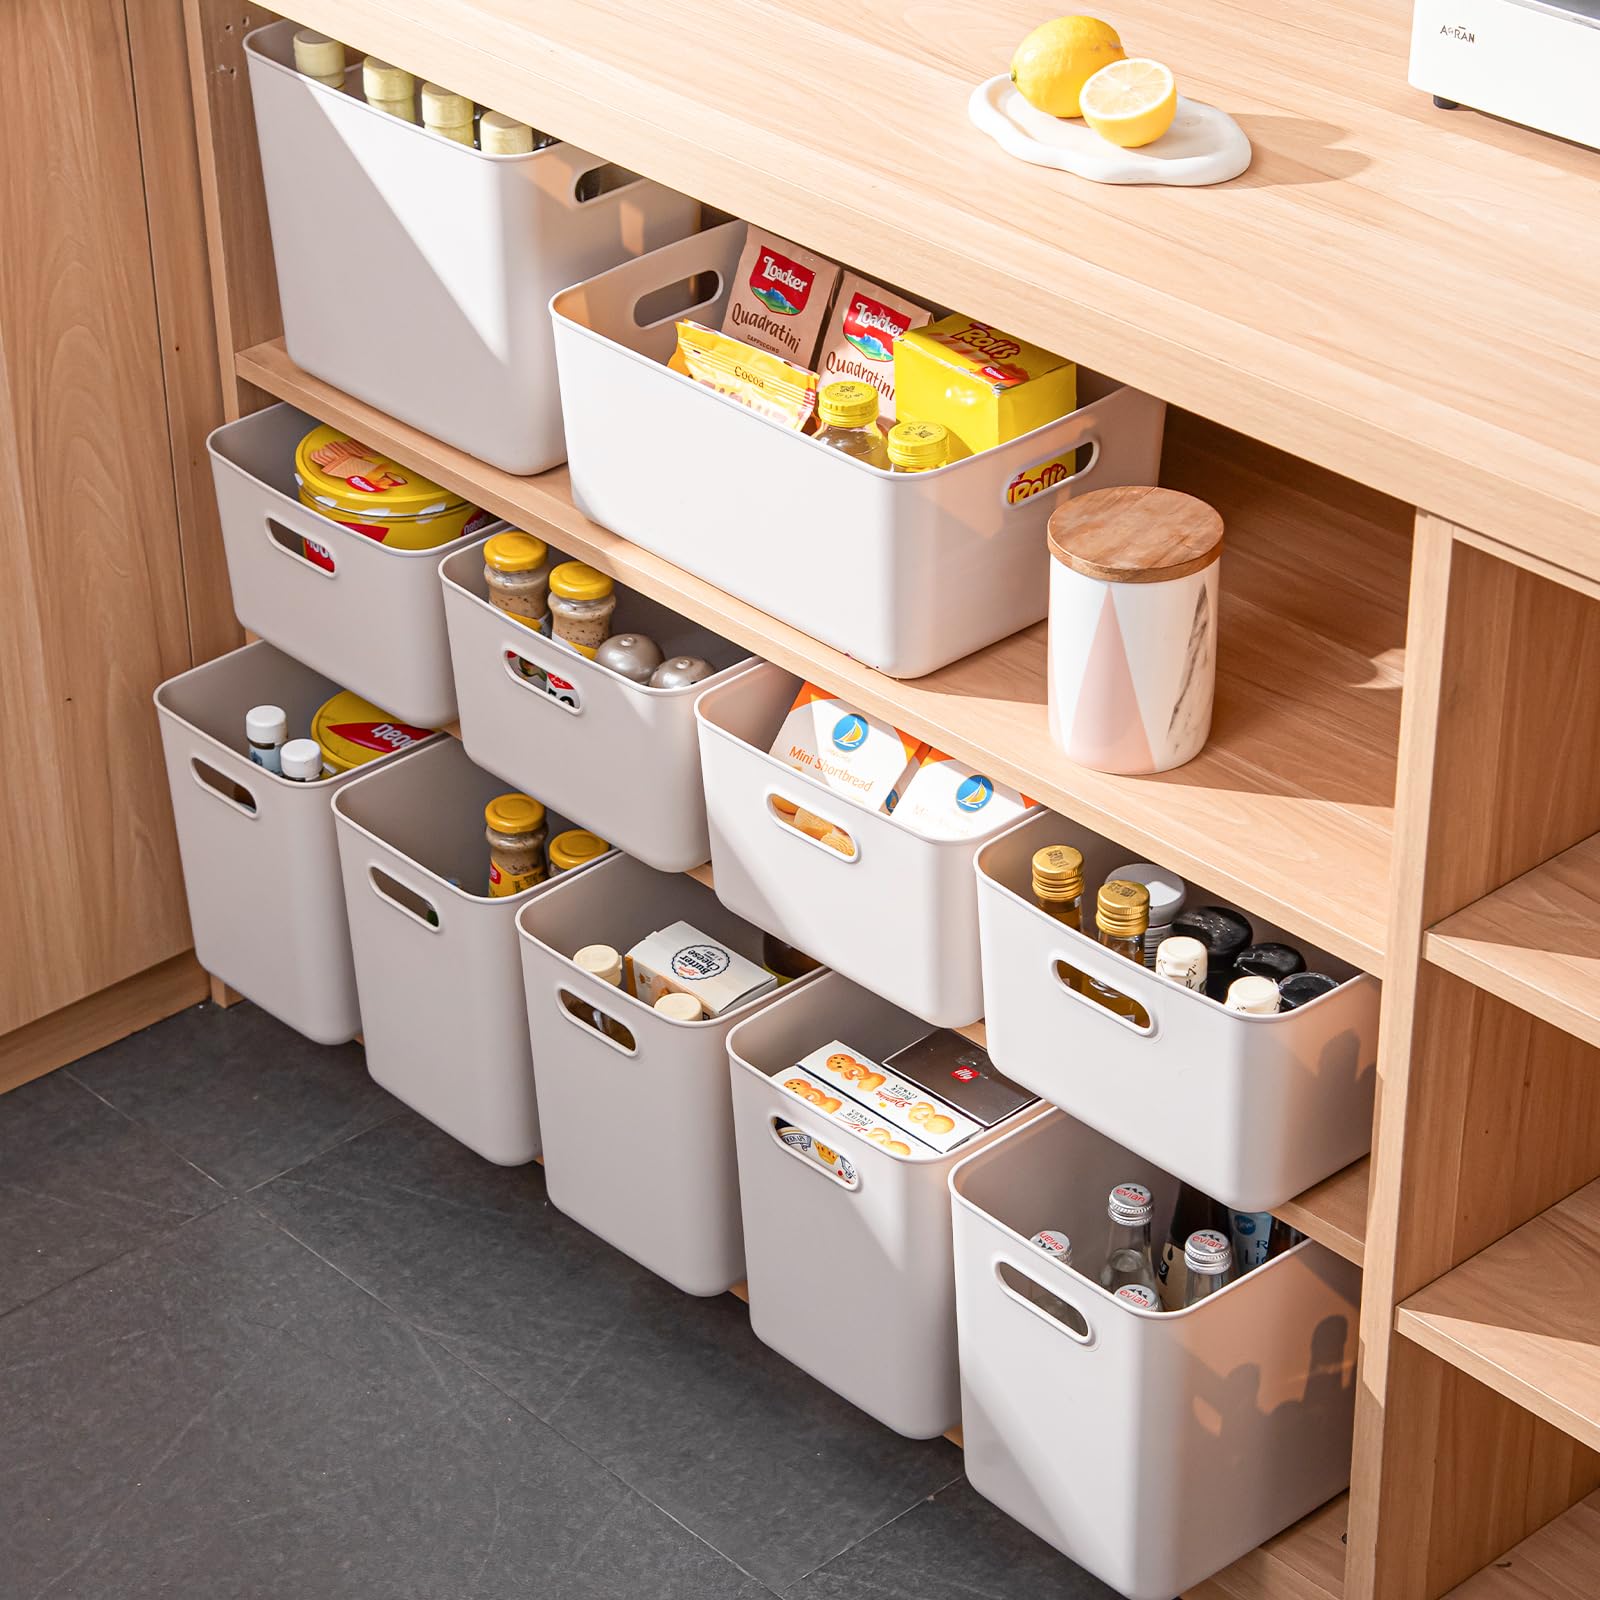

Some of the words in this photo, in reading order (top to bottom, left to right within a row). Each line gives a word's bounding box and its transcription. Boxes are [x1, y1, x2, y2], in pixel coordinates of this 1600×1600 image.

[763, 255, 808, 293] Loacker
[731, 303, 801, 354] Quadratini
[855, 302, 905, 340] Loacker
[734, 365, 765, 389] Cocoa
[826, 351, 896, 401] Quadratini
[789, 745, 812, 766] Mini
[814, 754, 875, 793] Shortbread
[679, 953, 711, 976] Butter
[687, 949, 720, 971] Cheese
[1115, 1187, 1146, 1204] evian
[1039, 1231, 1065, 1252] evian
[1192, 1233, 1224, 1249] evian
[1119, 1288, 1150, 1307] evian
